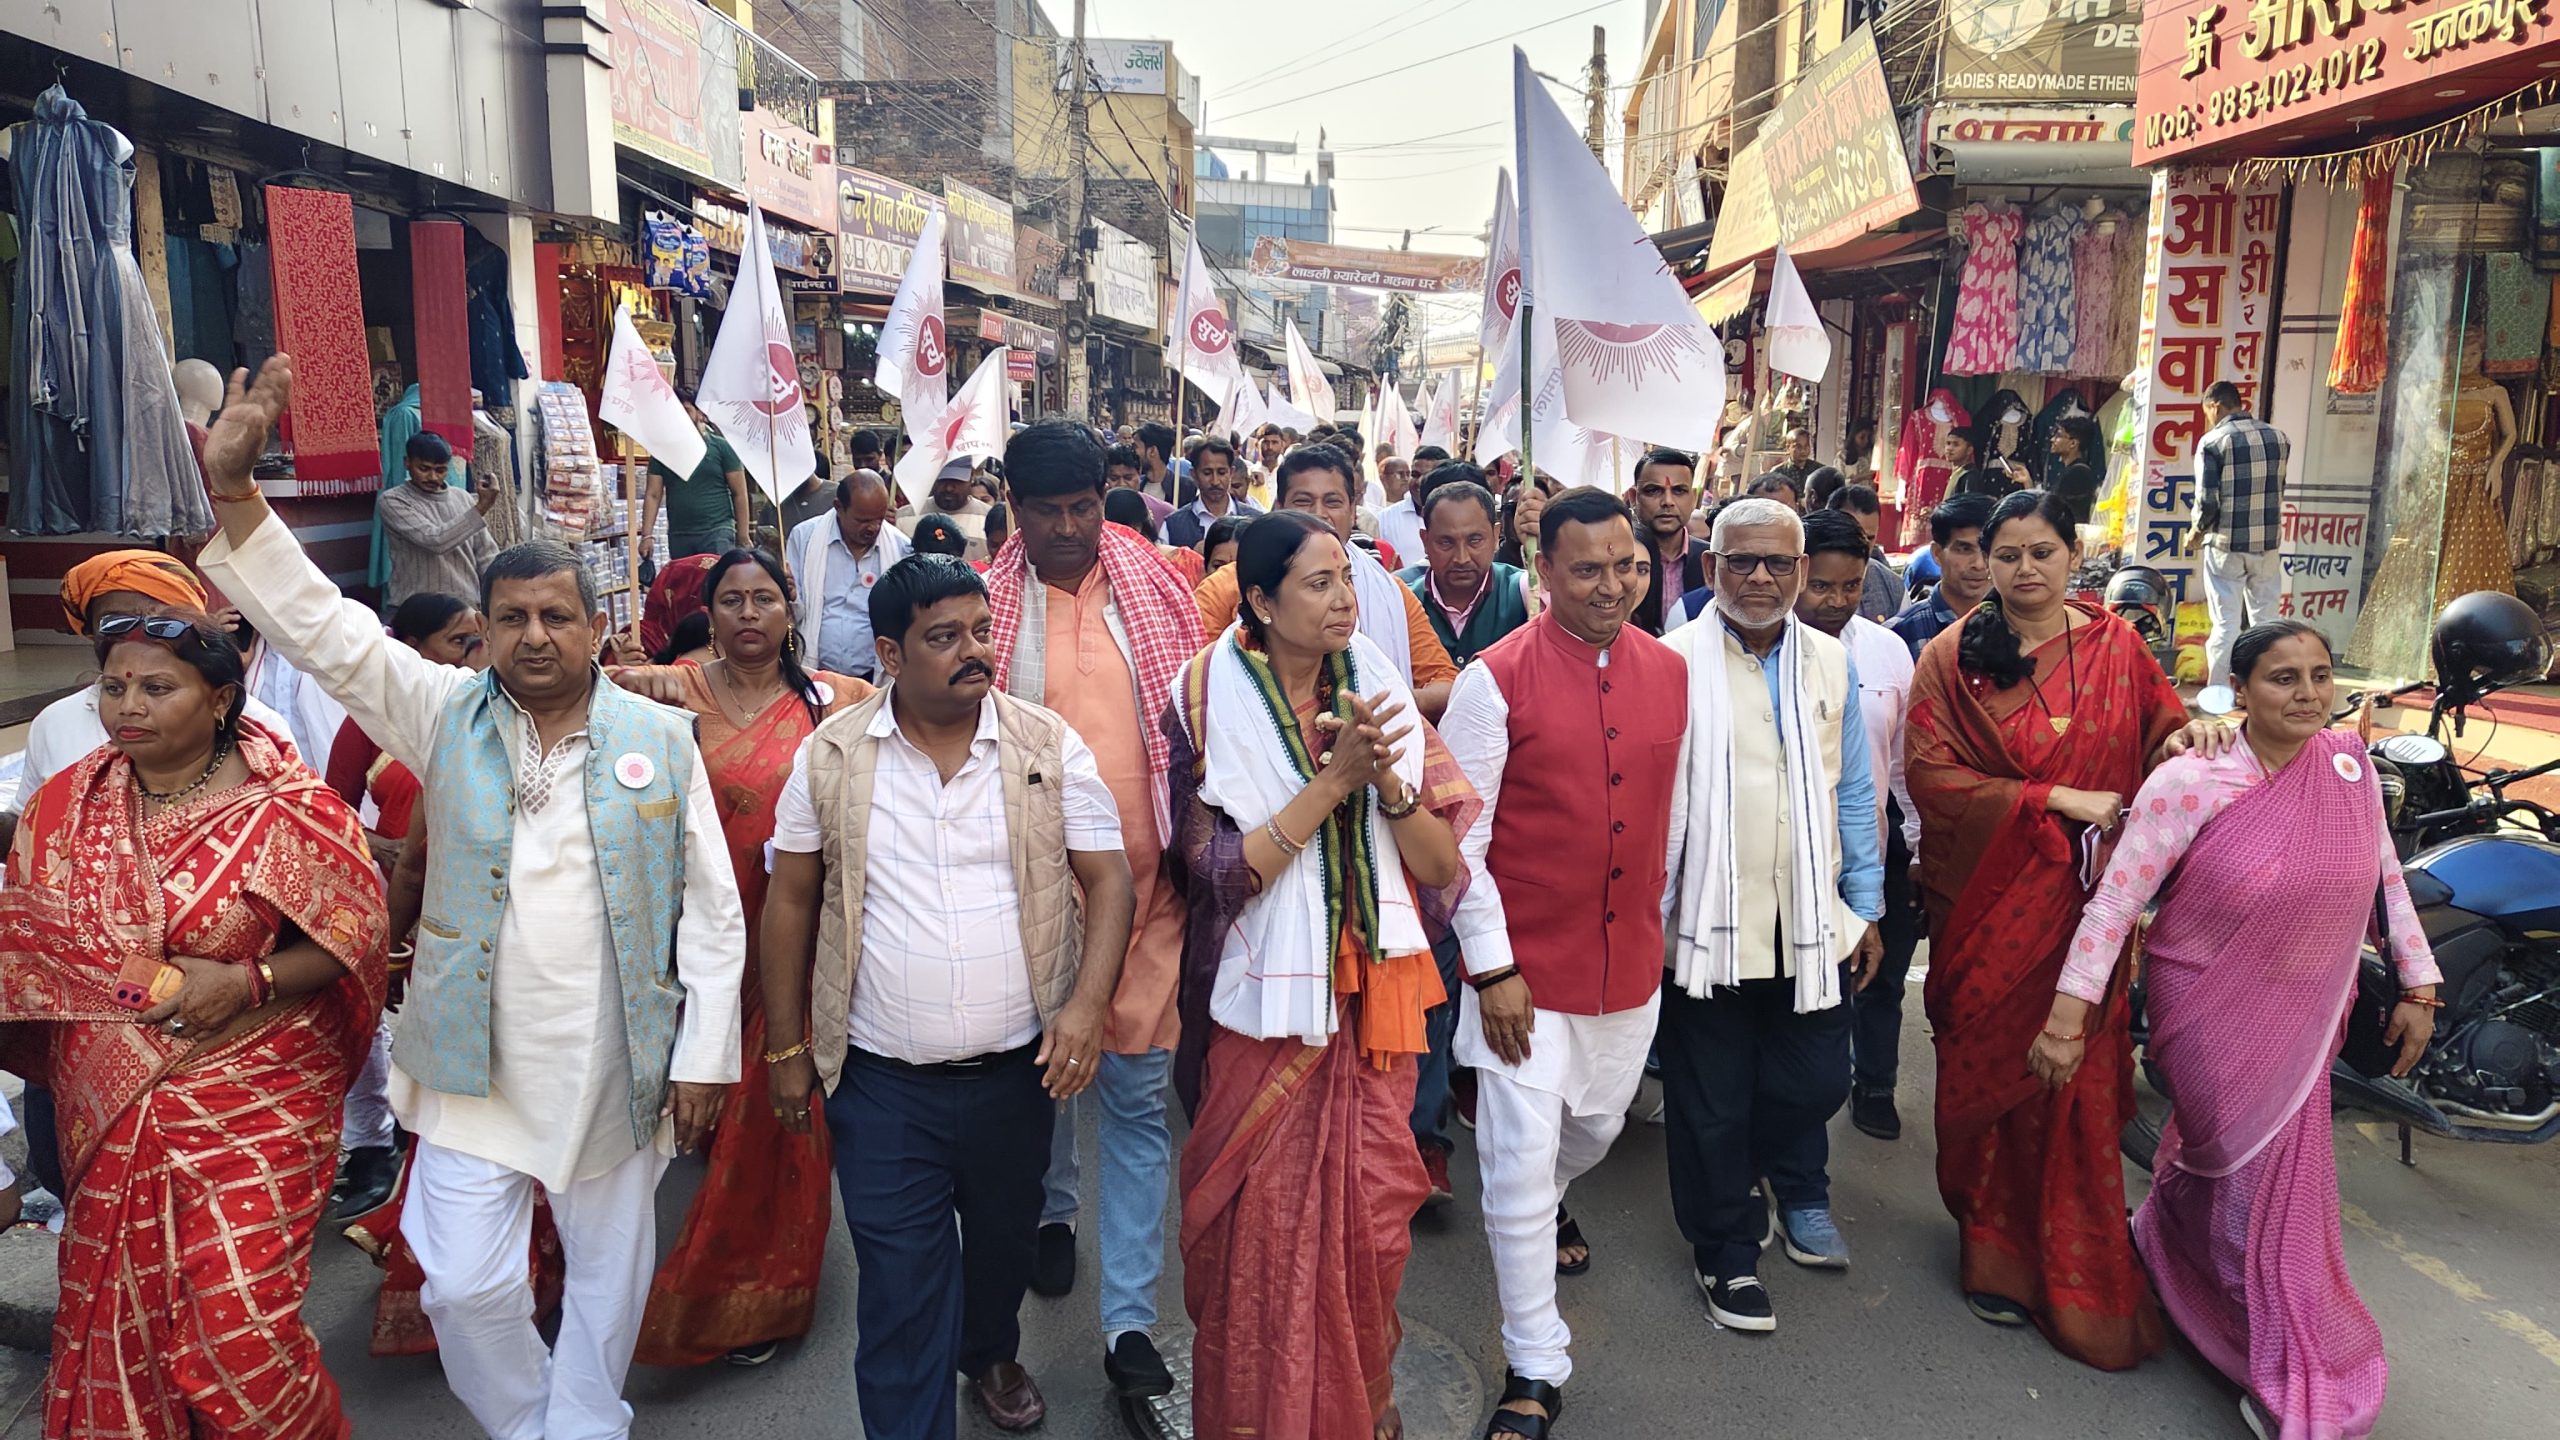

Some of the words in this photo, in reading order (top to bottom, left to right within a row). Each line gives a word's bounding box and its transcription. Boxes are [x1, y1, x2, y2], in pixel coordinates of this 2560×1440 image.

[1124, 49, 1164, 71] ज्वेलर्स
[1944, 73, 1995, 89] LADIES
[1998, 74, 2085, 90] READYMADE
[2144, 107, 2199, 149] Mob:
[2208, 38, 2381, 126] 9854024012
[1013, 352, 1034, 360] TITAN
[2279, 553, 2352, 579] स्त्रालय
[2301, 589, 2350, 620] दाम
